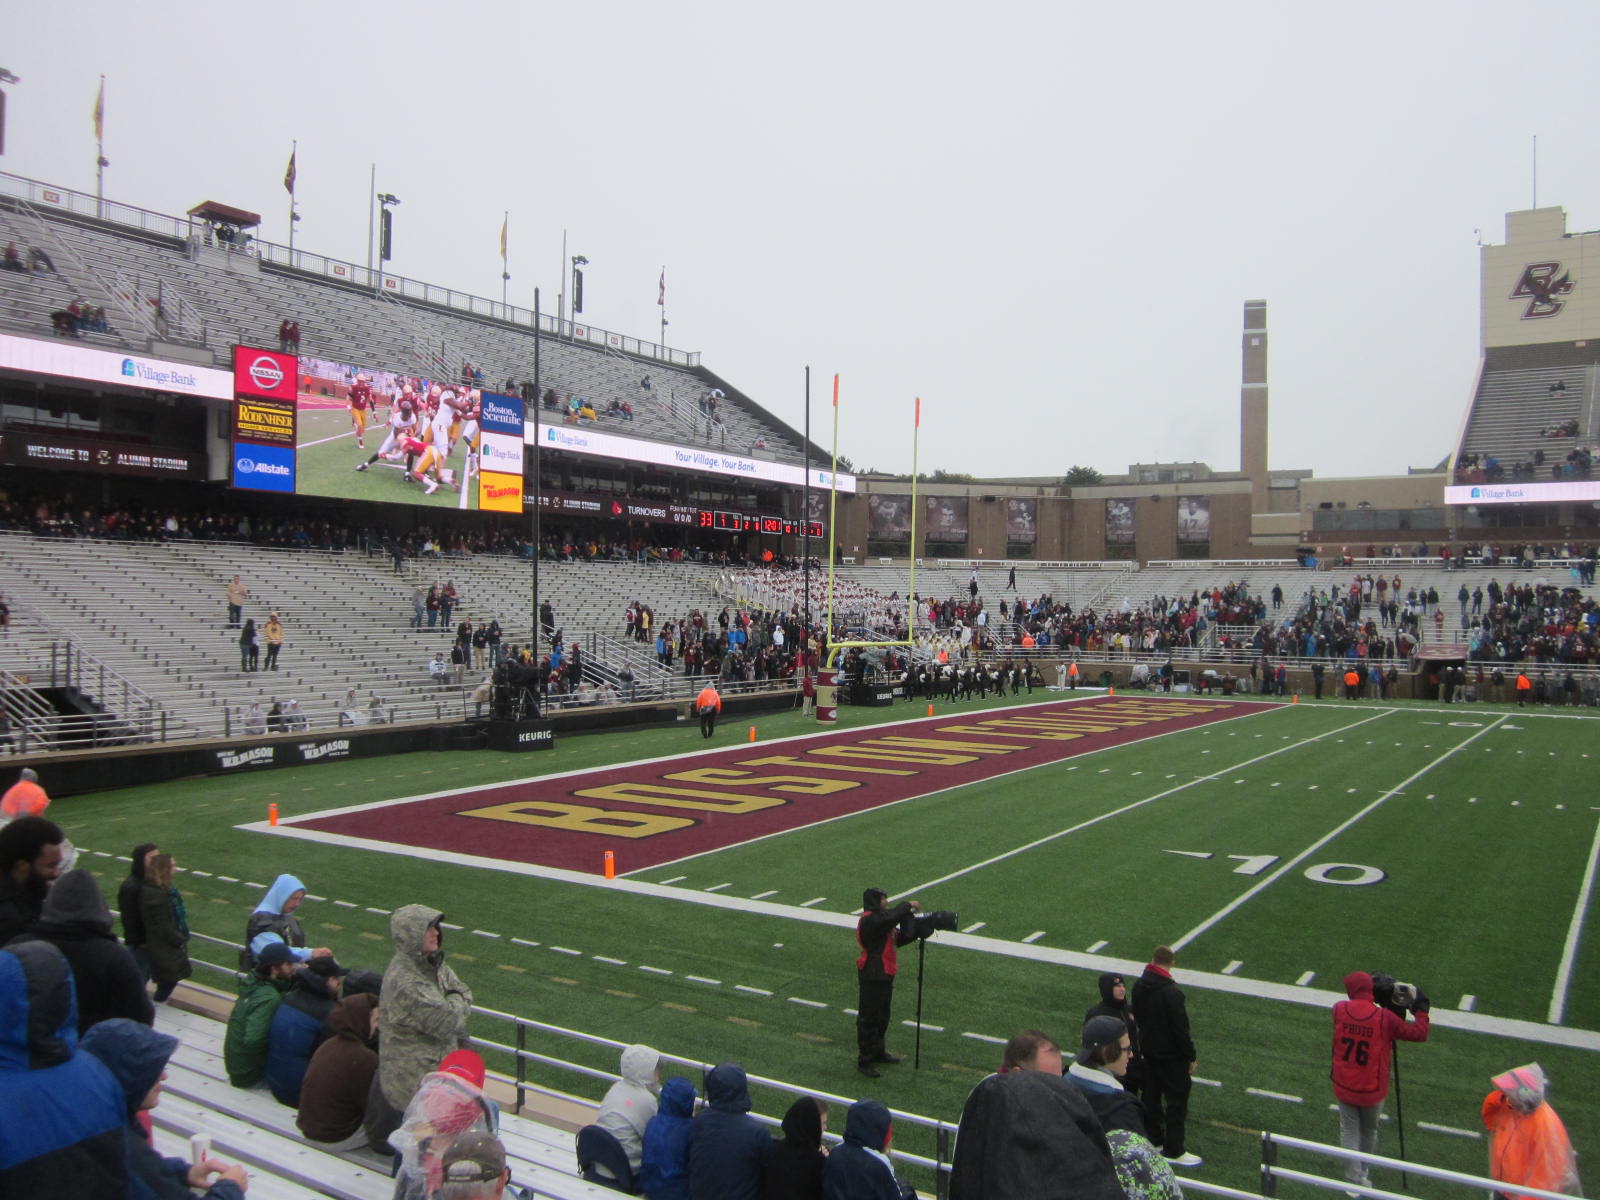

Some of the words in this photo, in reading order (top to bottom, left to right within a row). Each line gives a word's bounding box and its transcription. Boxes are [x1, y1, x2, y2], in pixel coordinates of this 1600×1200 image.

[136, 364, 169, 384] Village
[170, 371, 195, 386] Bank
[488, 401, 513, 415] Boston
[482, 408, 521, 426] Scientific
[27, 445, 75, 460] WELCOME
[78, 450, 89, 461] TO
[152, 456, 188, 471] STADIUM
[675, 450, 691, 462] Your
[694, 453, 720, 468] Village.
[722, 457, 736, 469] Your
[737, 460, 757, 473] Bank.
[254, 462, 290, 475] Allstate
[628, 505, 666, 518] TURNOVERS
[700, 512, 713, 527] 33
[519, 730, 552, 742] KEURIG
[453, 735, 1032, 840] BOSTON
[1342, 1022, 1373, 1038] PHOTO
[1342, 1037, 1370, 1066] 76
